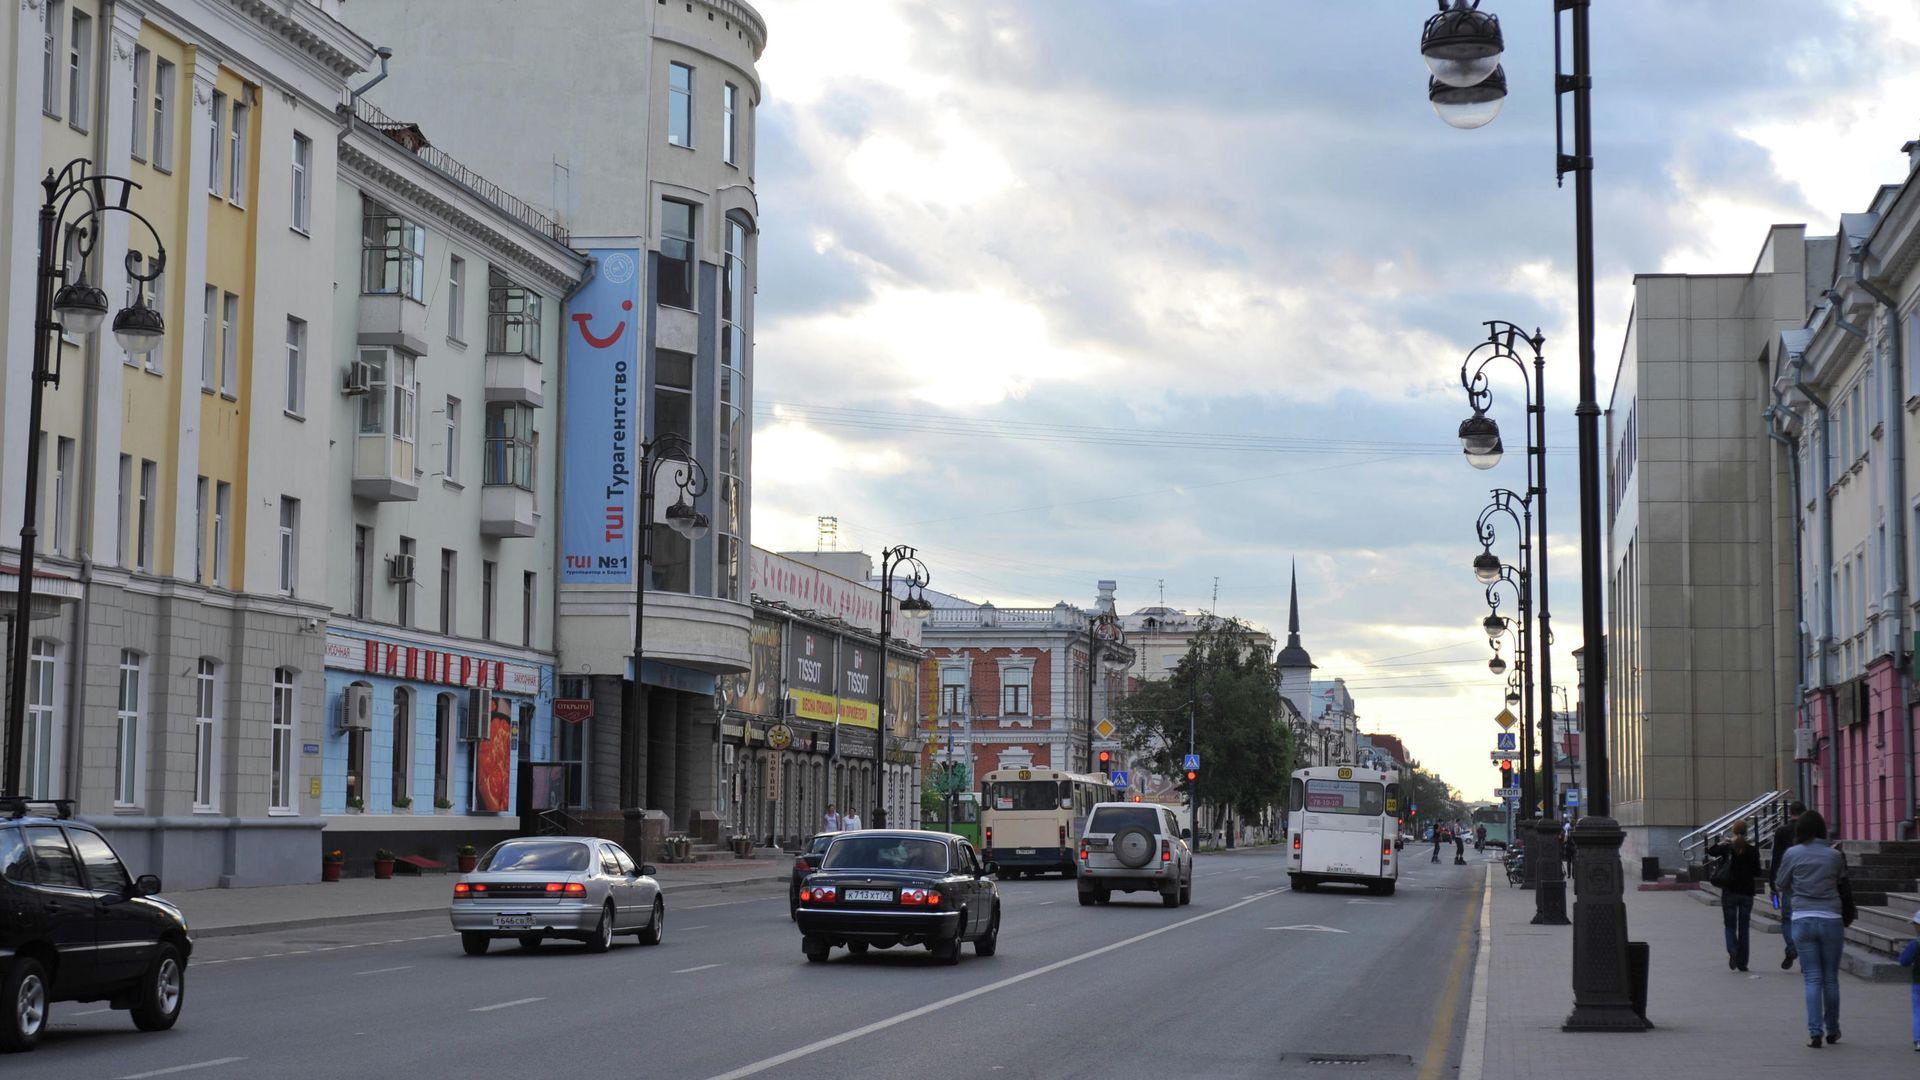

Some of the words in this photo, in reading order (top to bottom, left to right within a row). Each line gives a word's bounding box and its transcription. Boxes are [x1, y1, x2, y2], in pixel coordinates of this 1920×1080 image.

[606, 360, 629, 499] Турагентство
[605, 506, 624, 543] TUI
[566, 555, 591, 569] TUI
[598, 556, 627, 569] №1
[763, 555, 810, 599] Счастья
[365, 640, 504, 690] ПИЦЦЕРИЯ
[798, 658, 821, 684] TISSOT
[847, 671, 869, 695] TISSOT
[557, 703, 589, 711] ОТКРЫТО
